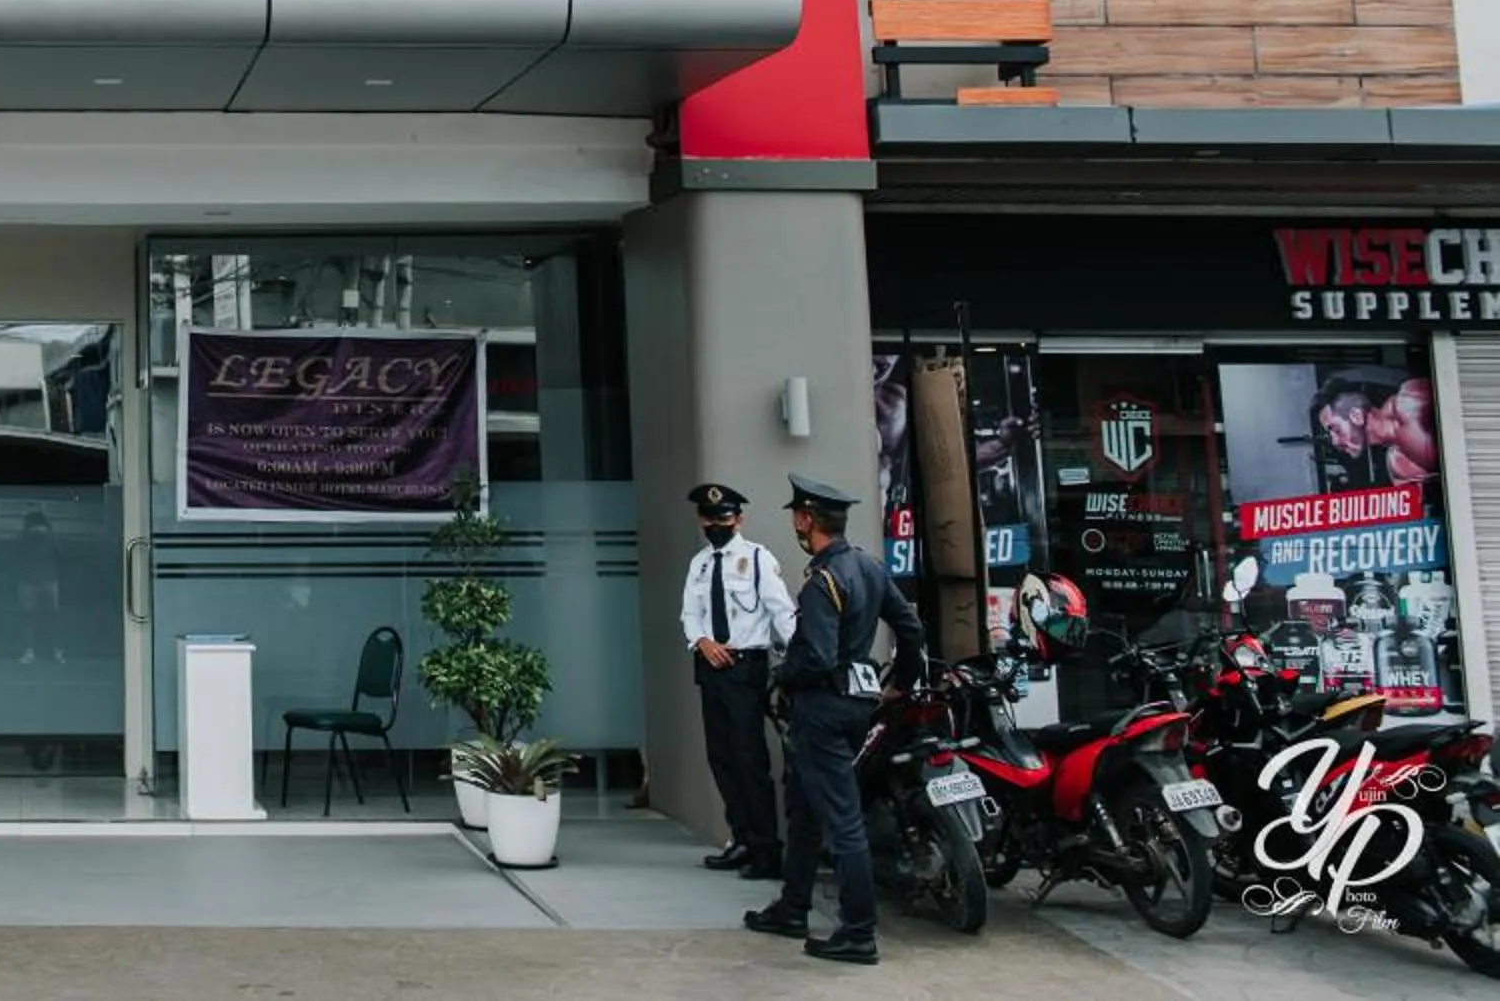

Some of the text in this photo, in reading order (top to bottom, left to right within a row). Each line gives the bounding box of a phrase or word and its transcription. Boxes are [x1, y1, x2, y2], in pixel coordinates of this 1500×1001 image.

[208, 354, 462, 401] LEGACY
[229, 422, 268, 437] NOW
[1085, 493, 1129, 512] WISE
[1253, 490, 1411, 534] MUSCLE BUILDING
[1271, 524, 1441, 574] AND RECOVERY
[1386, 670, 1430, 687] WHEY
